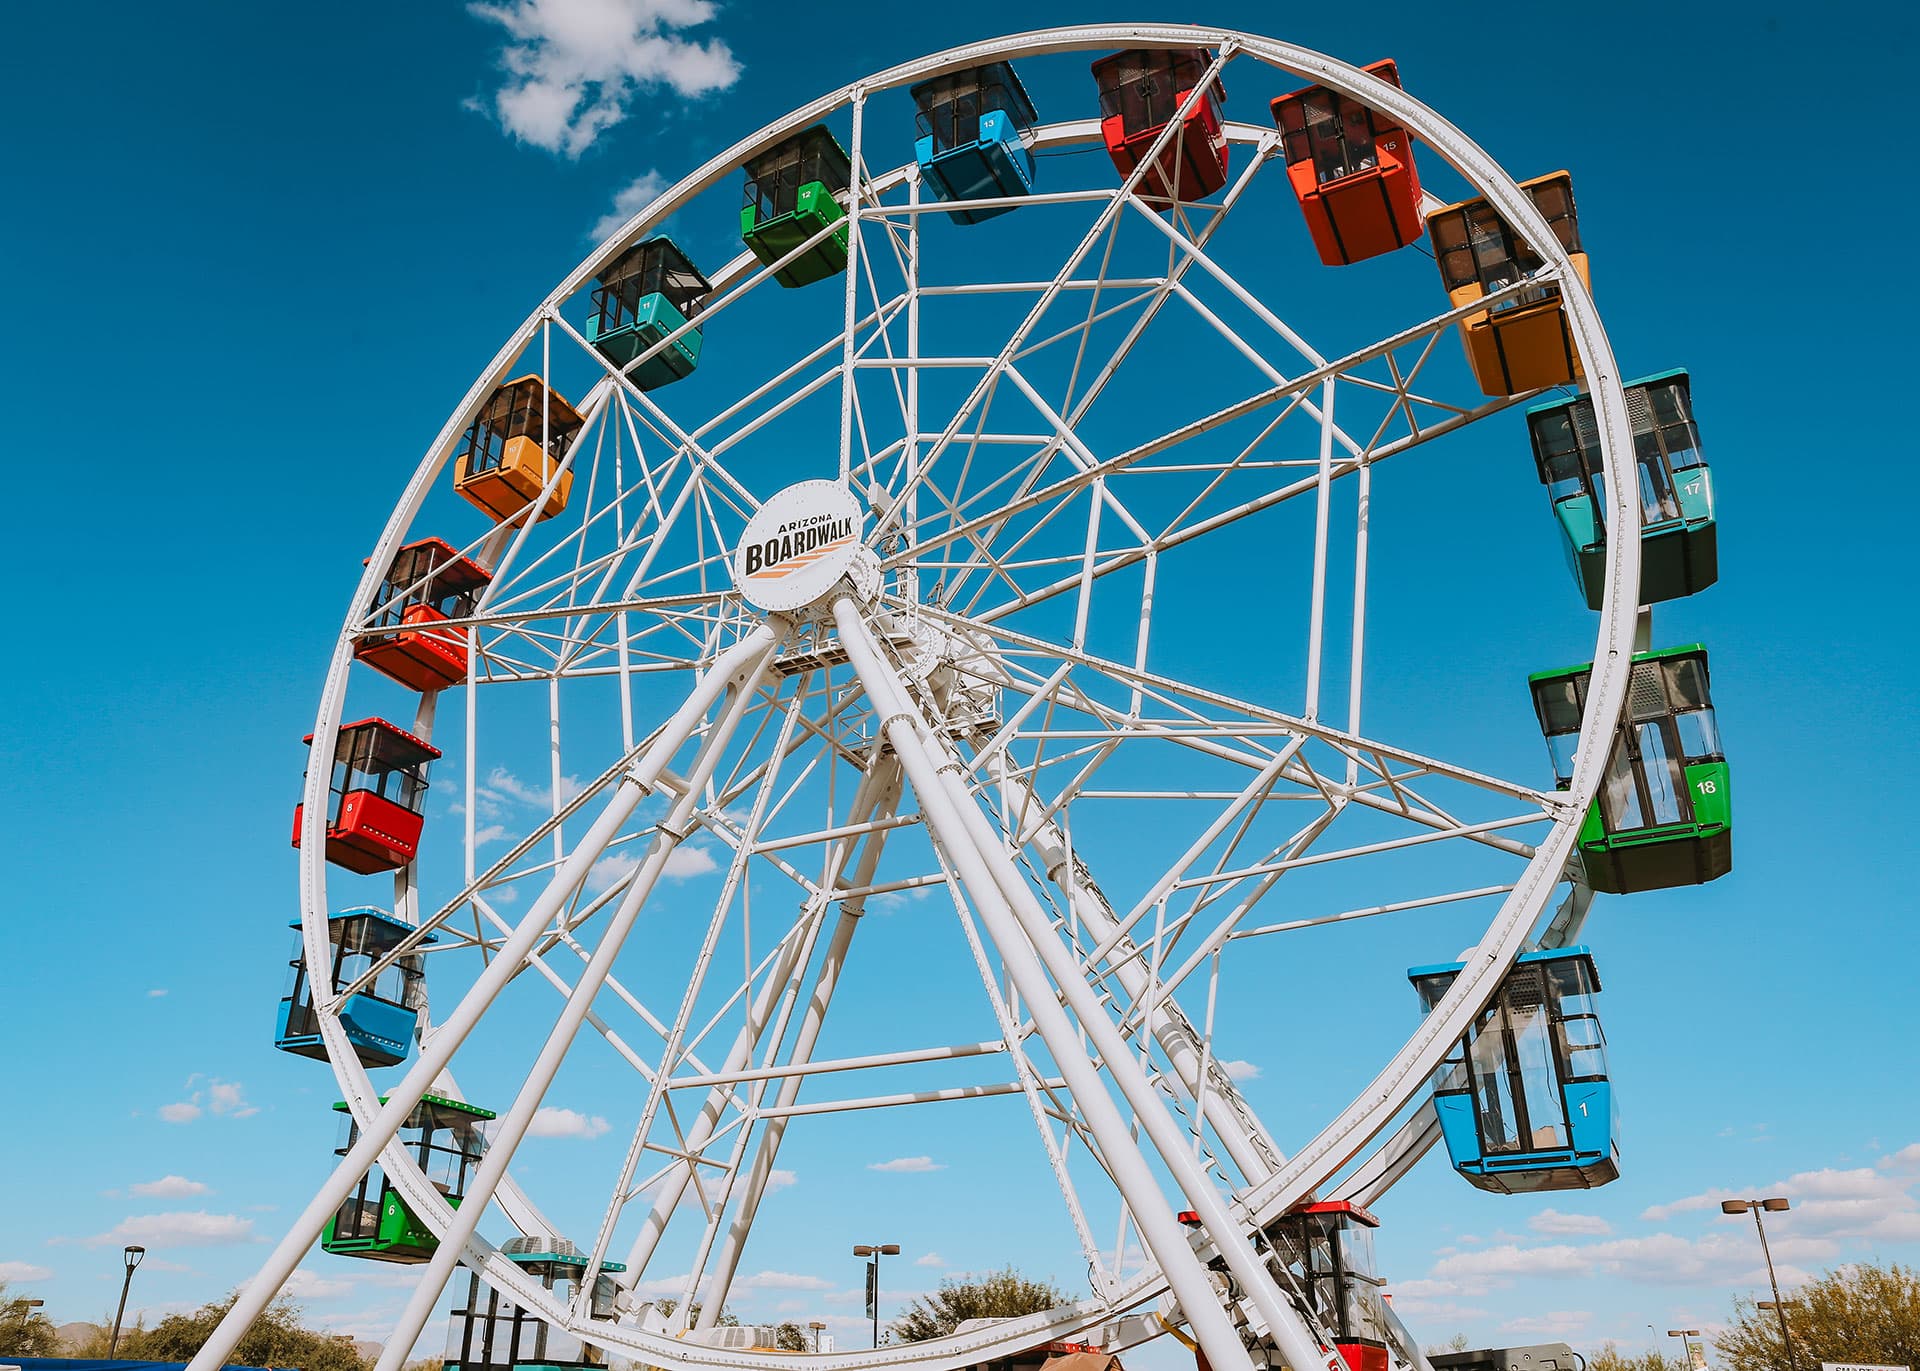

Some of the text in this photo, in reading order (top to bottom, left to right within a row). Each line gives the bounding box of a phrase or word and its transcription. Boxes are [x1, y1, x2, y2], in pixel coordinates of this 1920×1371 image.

[984, 119, 994, 128] 13
[1383, 141, 1397, 151] 15
[801, 191, 811, 199] 12
[1684, 483, 1700, 496] 17
[778, 513, 832, 534] ARIZONA
[745, 517, 852, 577] BOARDWALK
[407, 615, 413, 623] 9
[1696, 780, 1717, 795] 18
[346, 803, 353, 812] 8
[1579, 1102, 1588, 1117] 1
[388, 1205, 395, 1215] 6
